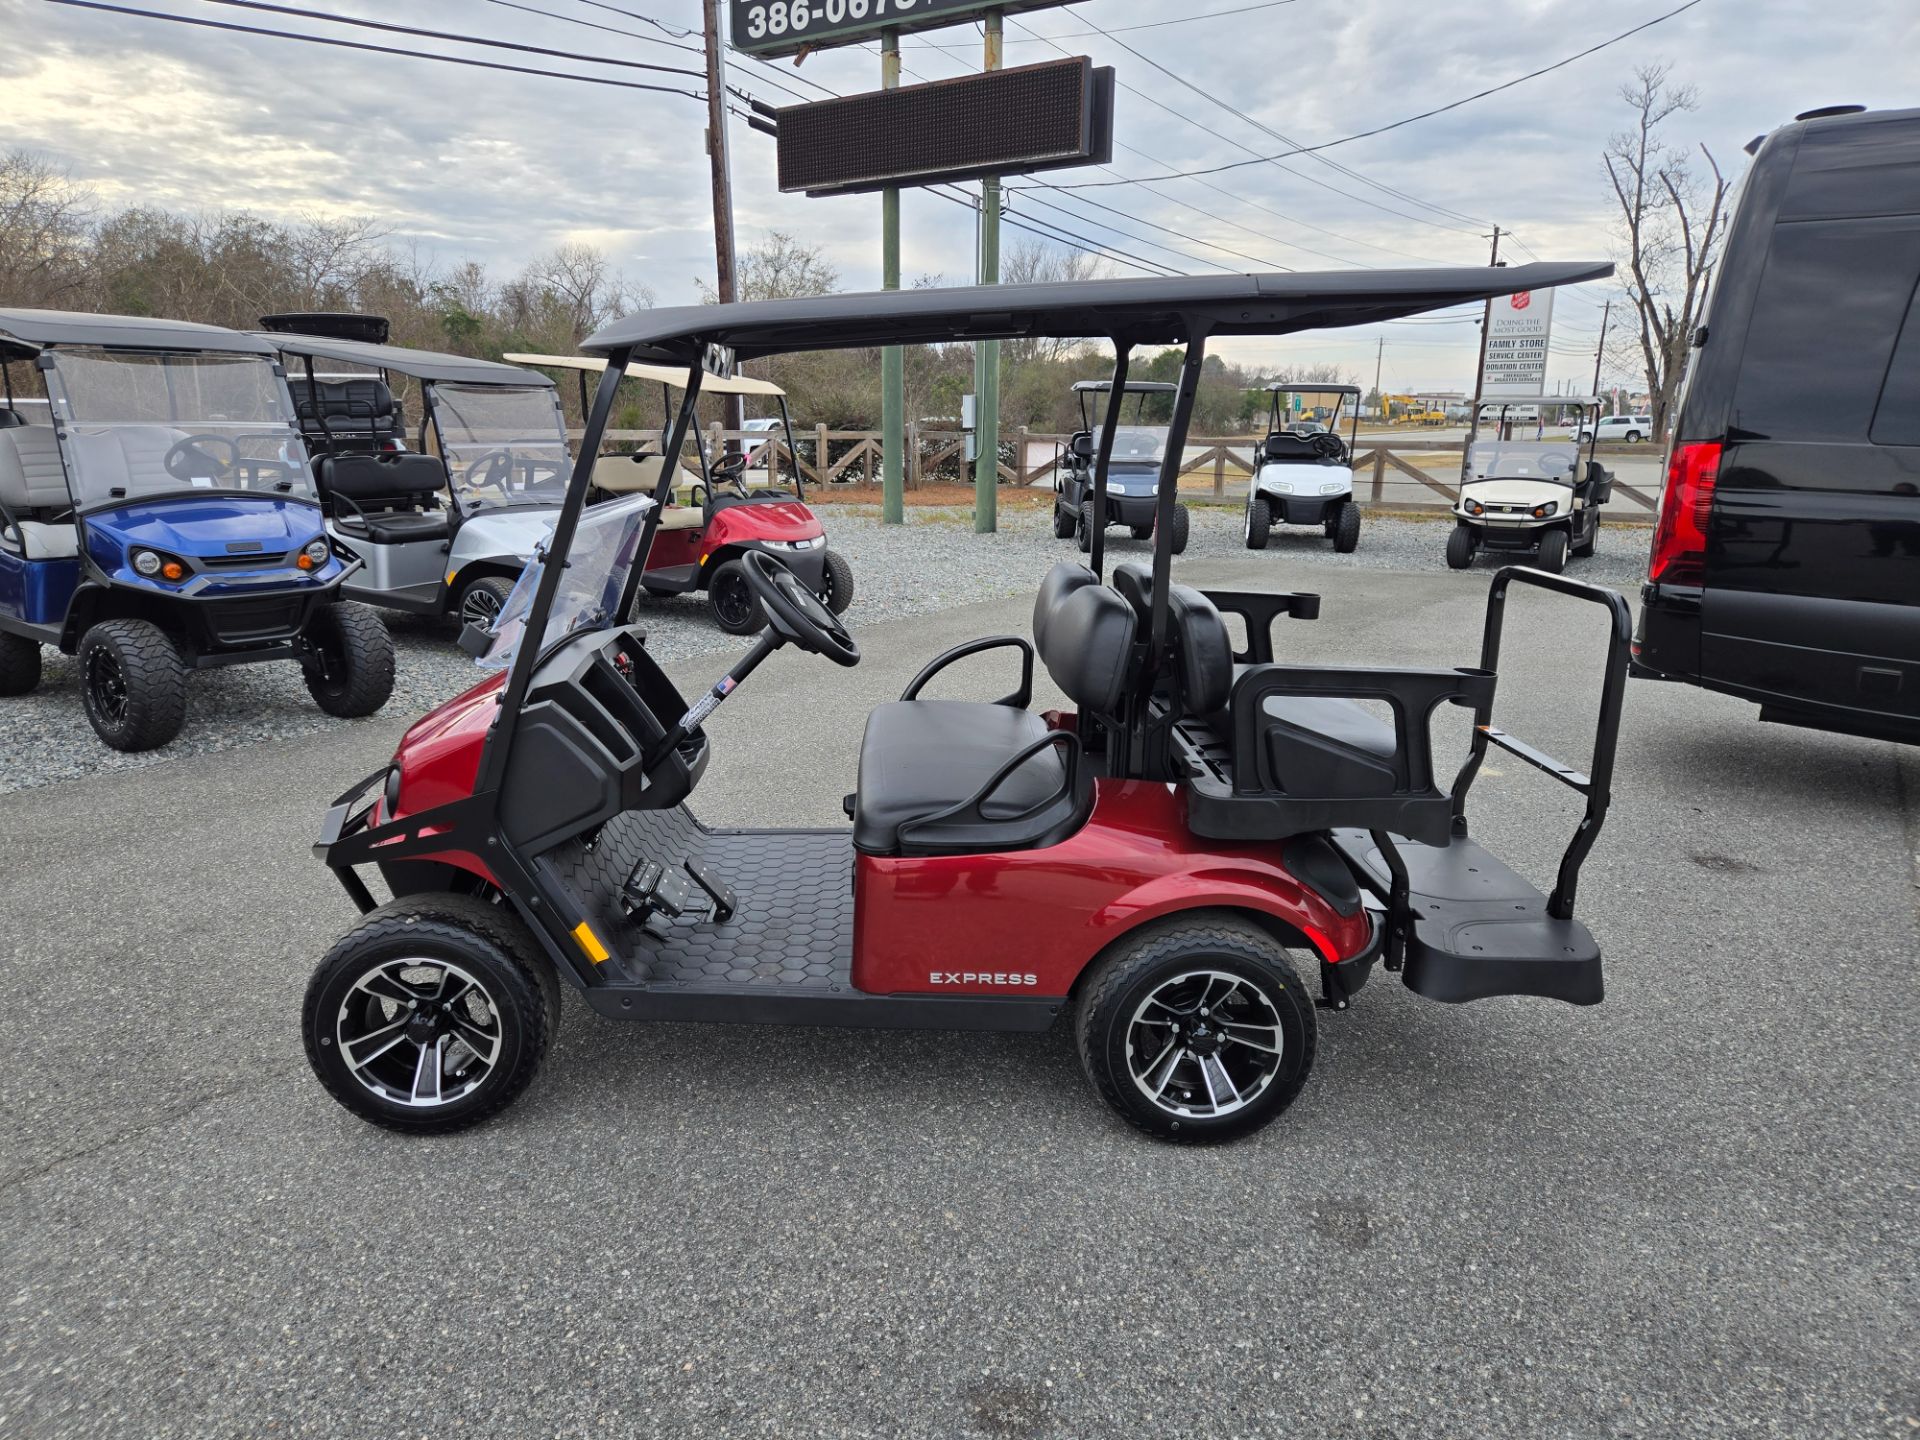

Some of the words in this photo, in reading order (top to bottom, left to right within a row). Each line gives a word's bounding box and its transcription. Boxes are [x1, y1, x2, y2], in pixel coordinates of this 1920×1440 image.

[748, 0, 917, 39] 386-06
[1496, 319, 1524, 327] DOING
[1526, 318, 1541, 326] THE
[1518, 325, 1543, 333] GOOD
[1489, 339, 1517, 349] FAMILY
[1520, 339, 1545, 348] STORE
[1488, 352, 1515, 360] SERVICE
[1517, 351, 1542, 359] CENTER
[1486, 363, 1518, 371] DONATION
[1519, 362, 1543, 370] CENTER
[929, 972, 1038, 986] EXPRESS
